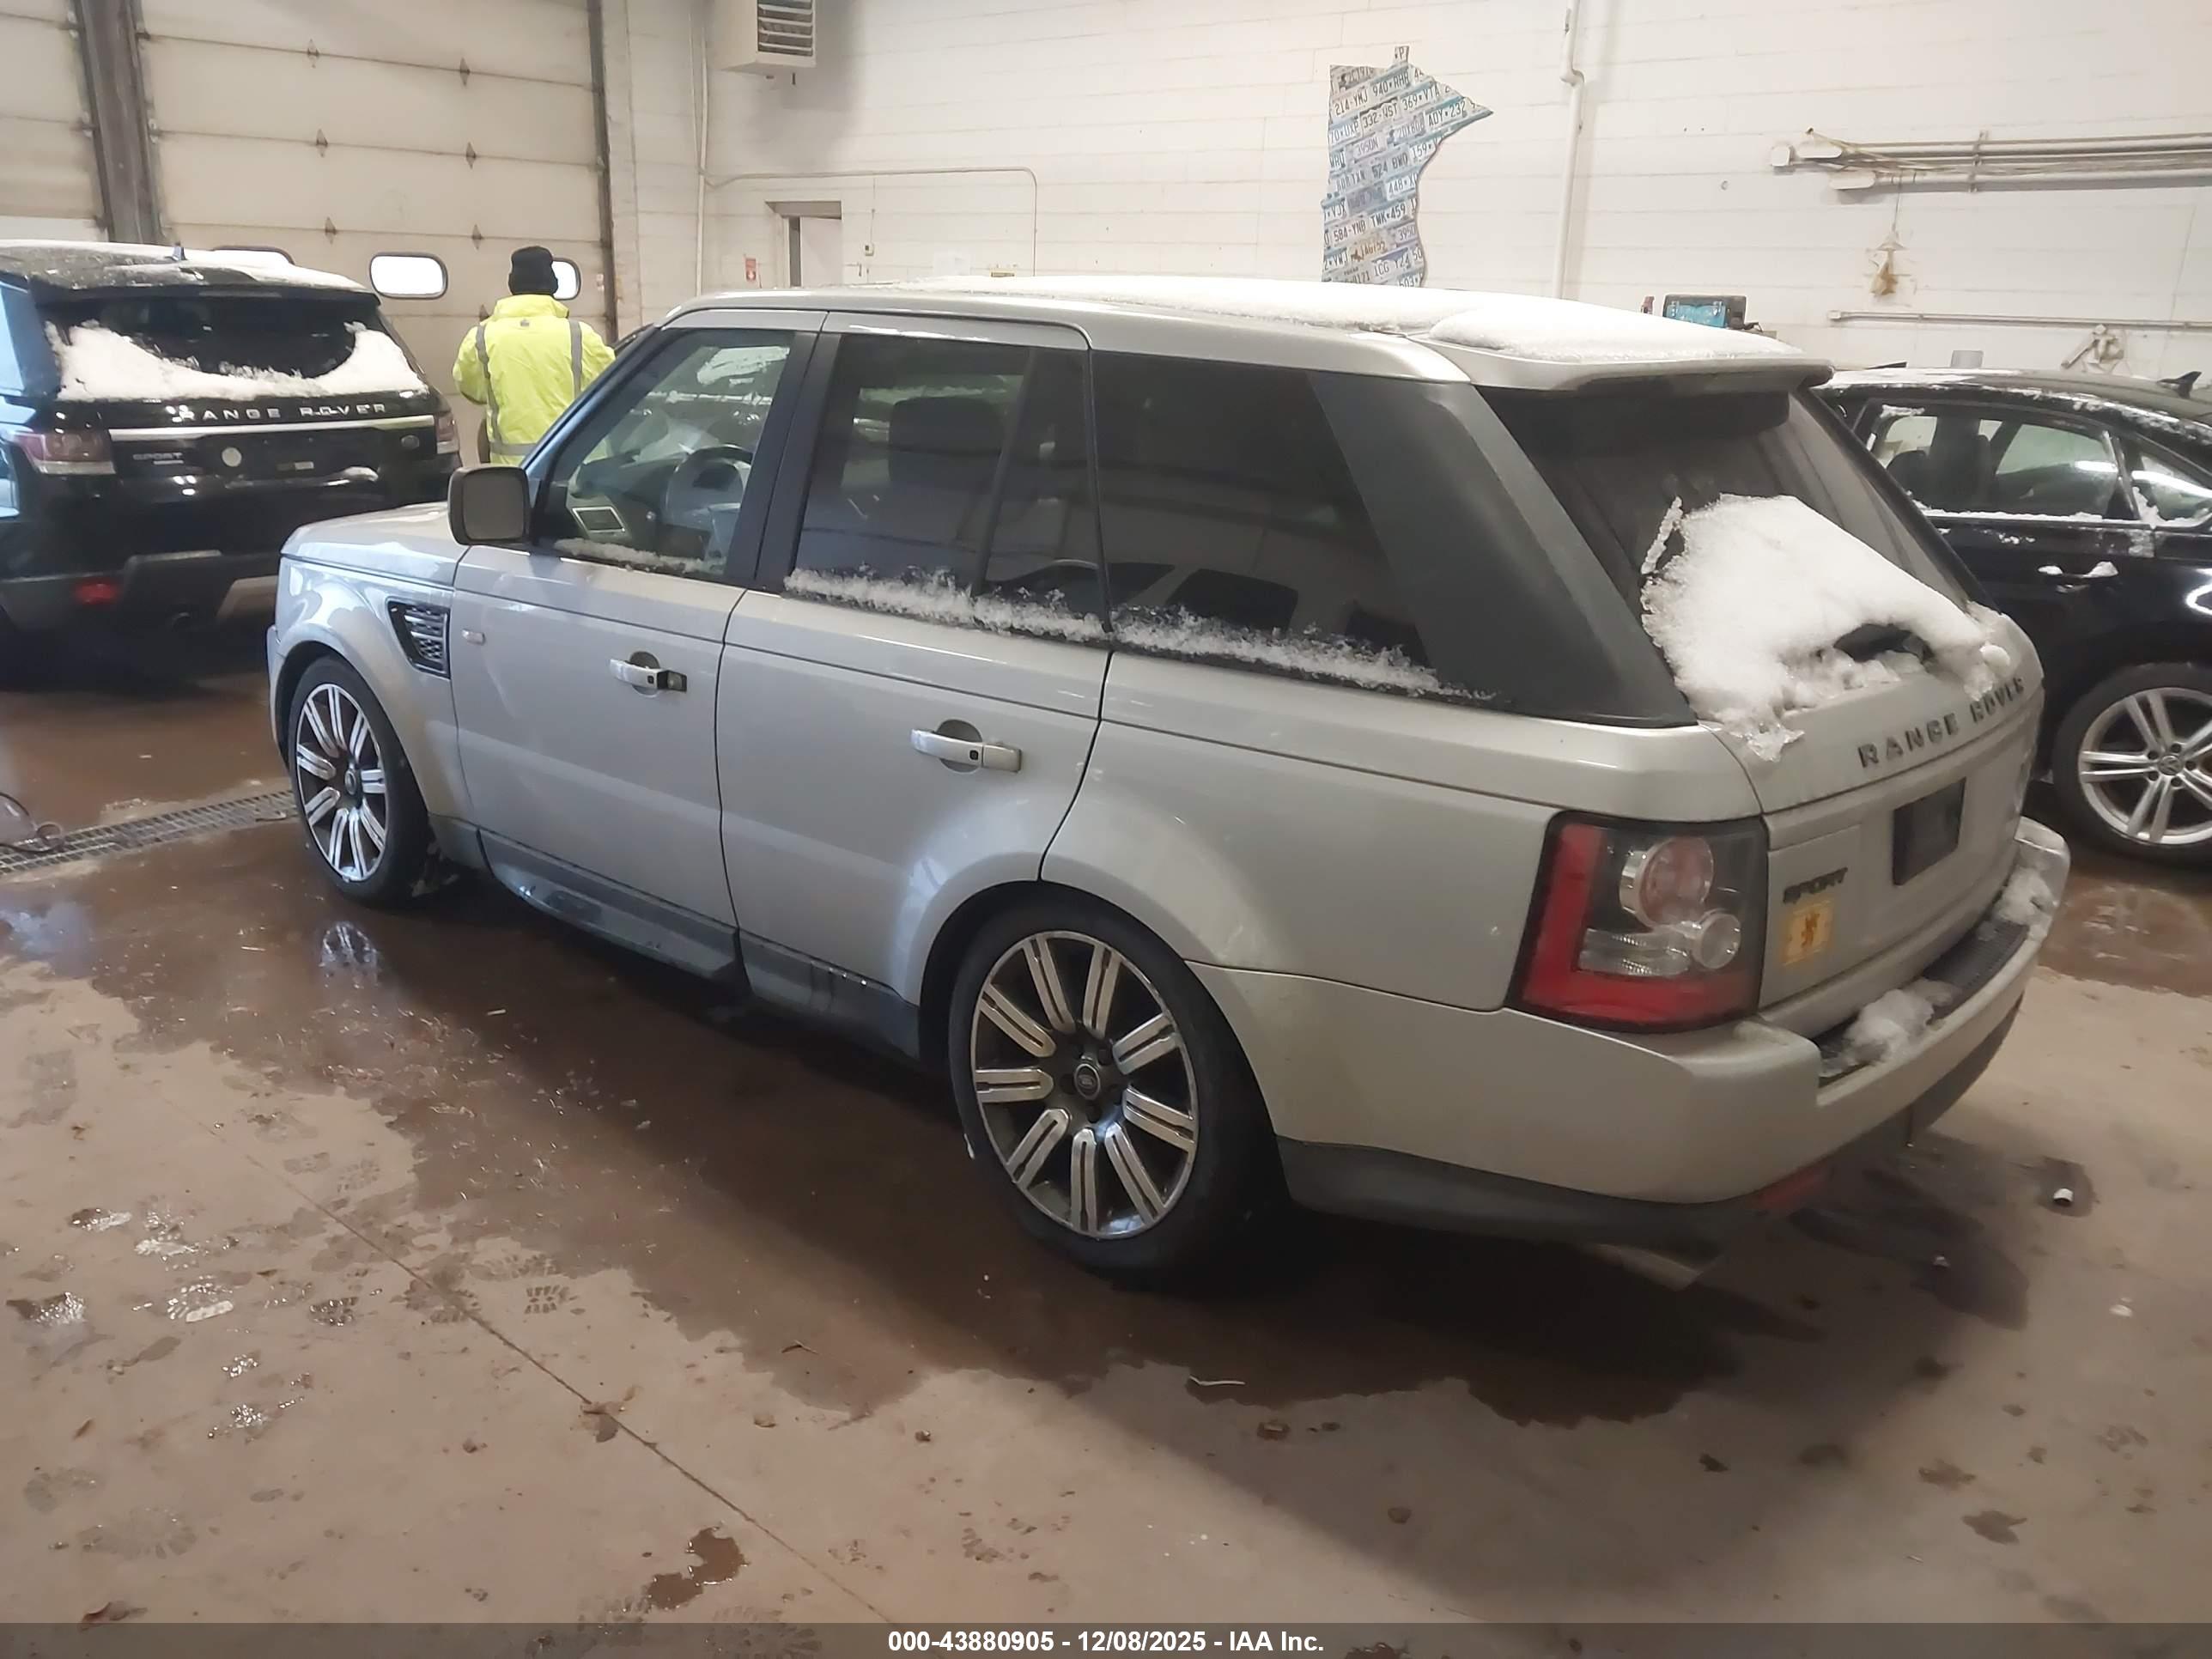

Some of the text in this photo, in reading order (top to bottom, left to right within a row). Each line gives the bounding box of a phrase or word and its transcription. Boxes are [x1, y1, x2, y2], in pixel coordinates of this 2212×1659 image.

[179, 403, 386, 422] RANGE ROVER
[1857, 713, 1960, 768] RANGE
